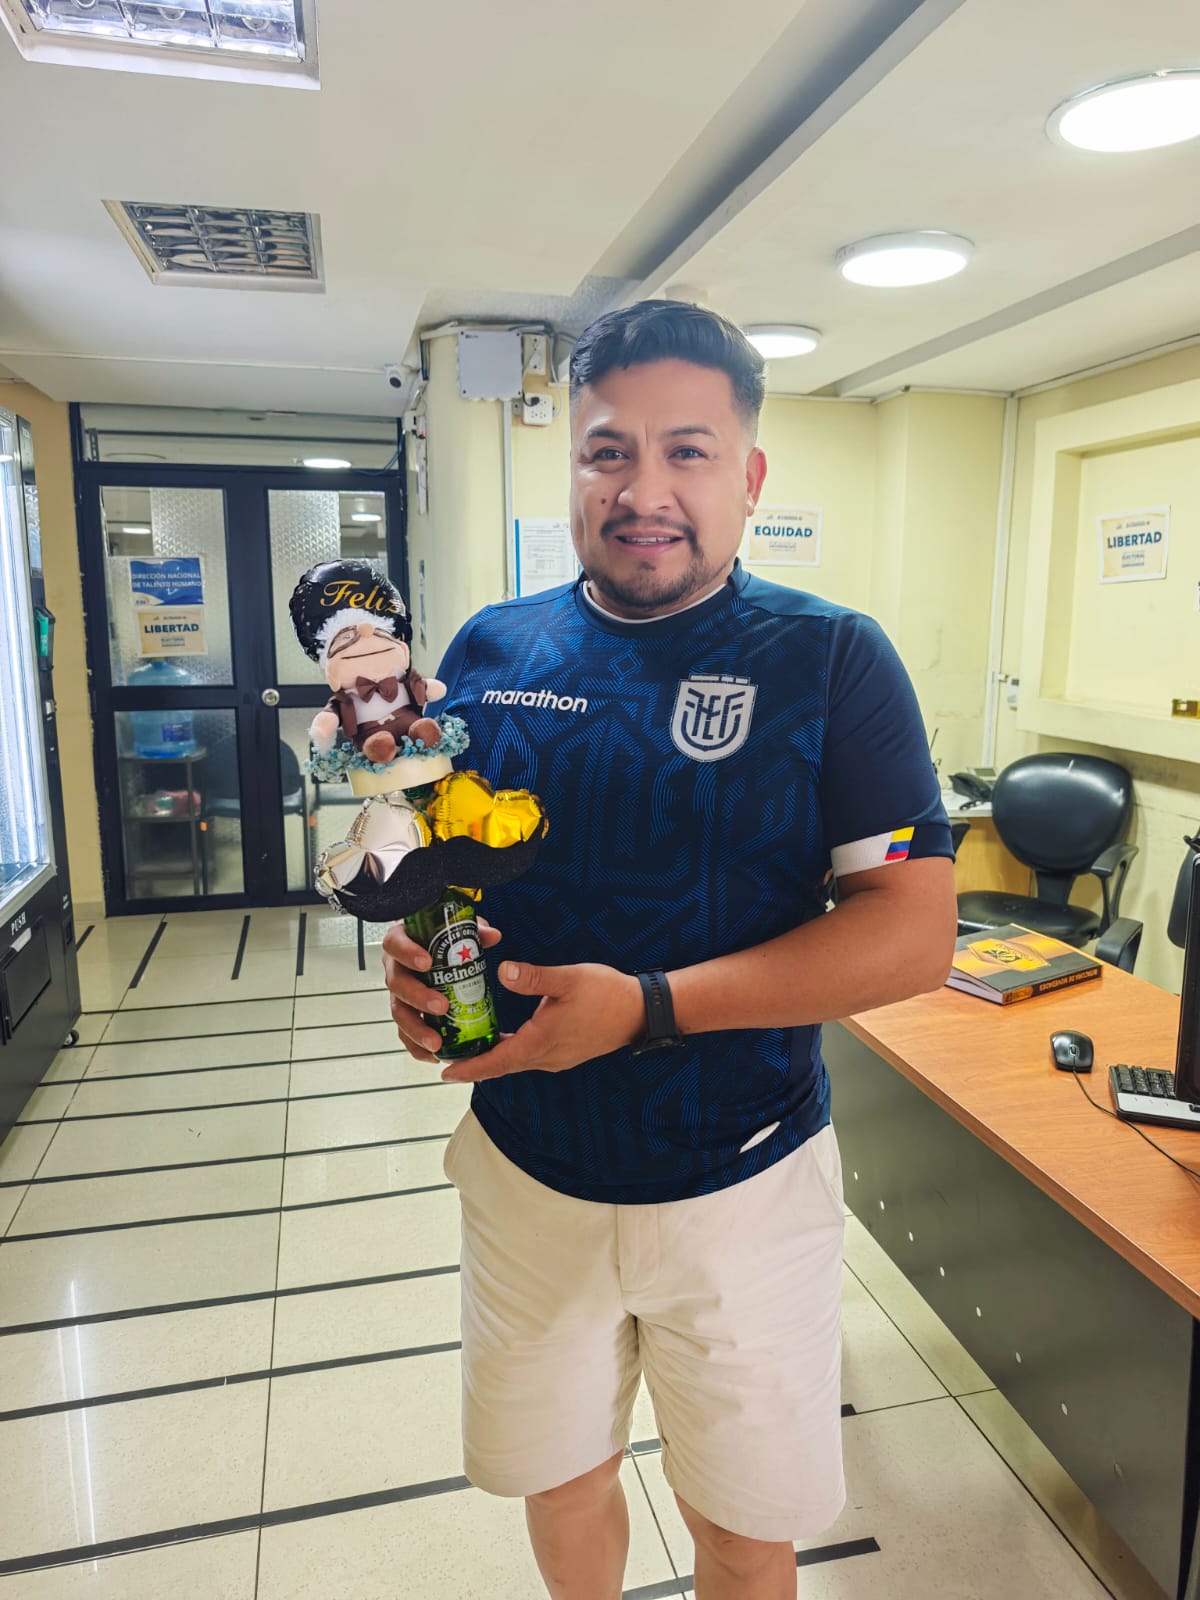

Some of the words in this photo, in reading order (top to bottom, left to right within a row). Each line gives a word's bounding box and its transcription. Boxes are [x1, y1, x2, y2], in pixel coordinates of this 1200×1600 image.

[754, 526, 813, 538] EQUIDAD
[1107, 531, 1162, 549] LIBERTAD
[142, 581, 170, 589] TALENTO
[172, 580, 202, 588] HUMANO
[320, 580, 401, 614] Feliz
[144, 623, 200, 635] LIBERTAD
[481, 689, 588, 713] marathon
[11, 911, 26, 936] PUSH
[433, 959, 487, 985] Heineke
